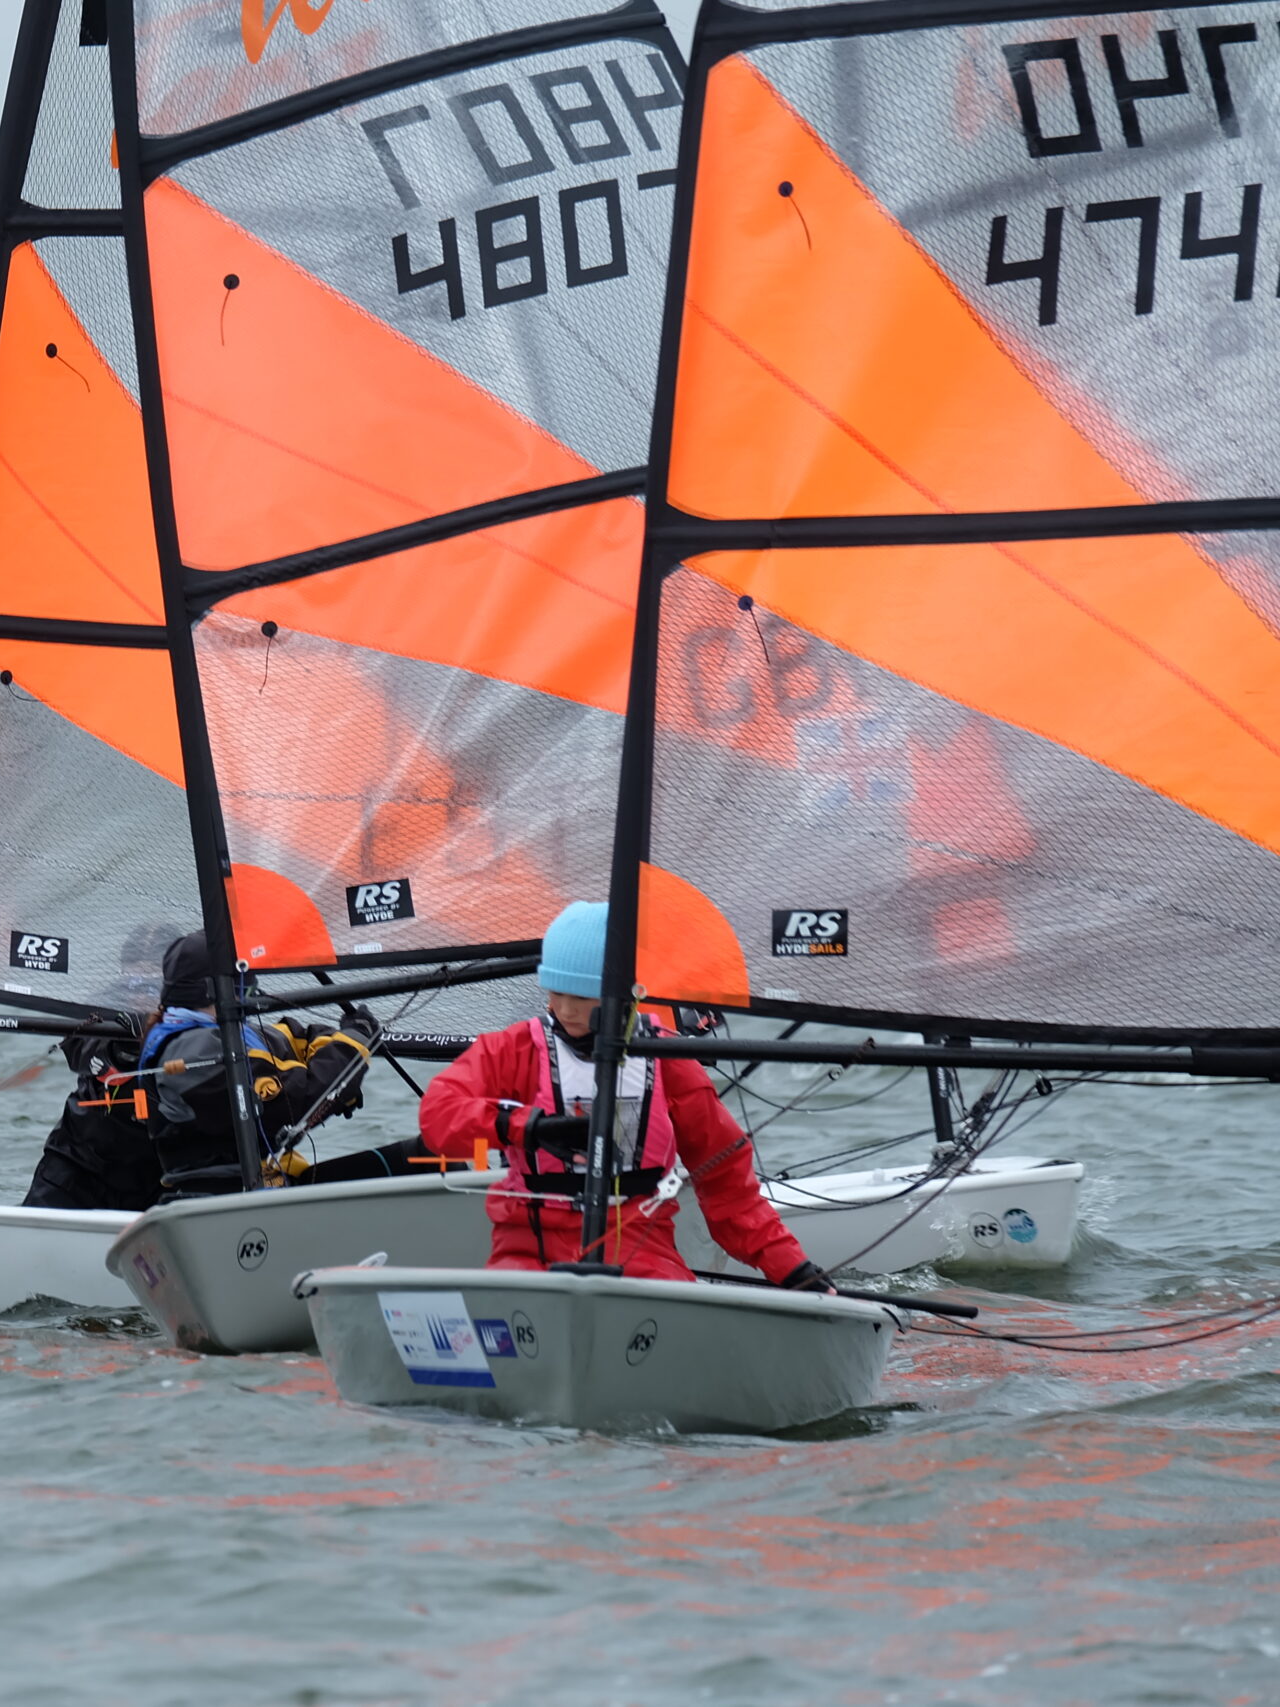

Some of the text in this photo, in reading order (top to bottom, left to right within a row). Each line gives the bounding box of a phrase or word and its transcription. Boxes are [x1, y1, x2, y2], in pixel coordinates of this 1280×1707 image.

[986, 183, 1280, 326] 474
[355, 881, 401, 908] RS
[365, 909, 394, 923] HYDE
[784, 911, 842, 937] RS
[17, 935, 61, 957] RS
[24, 959, 51, 970] HYDE
[974, 1222, 998, 1238] RS
[239, 1240, 266, 1259] RS
[515, 1325, 535, 1344] RS
[628, 1333, 656, 1352] RS
